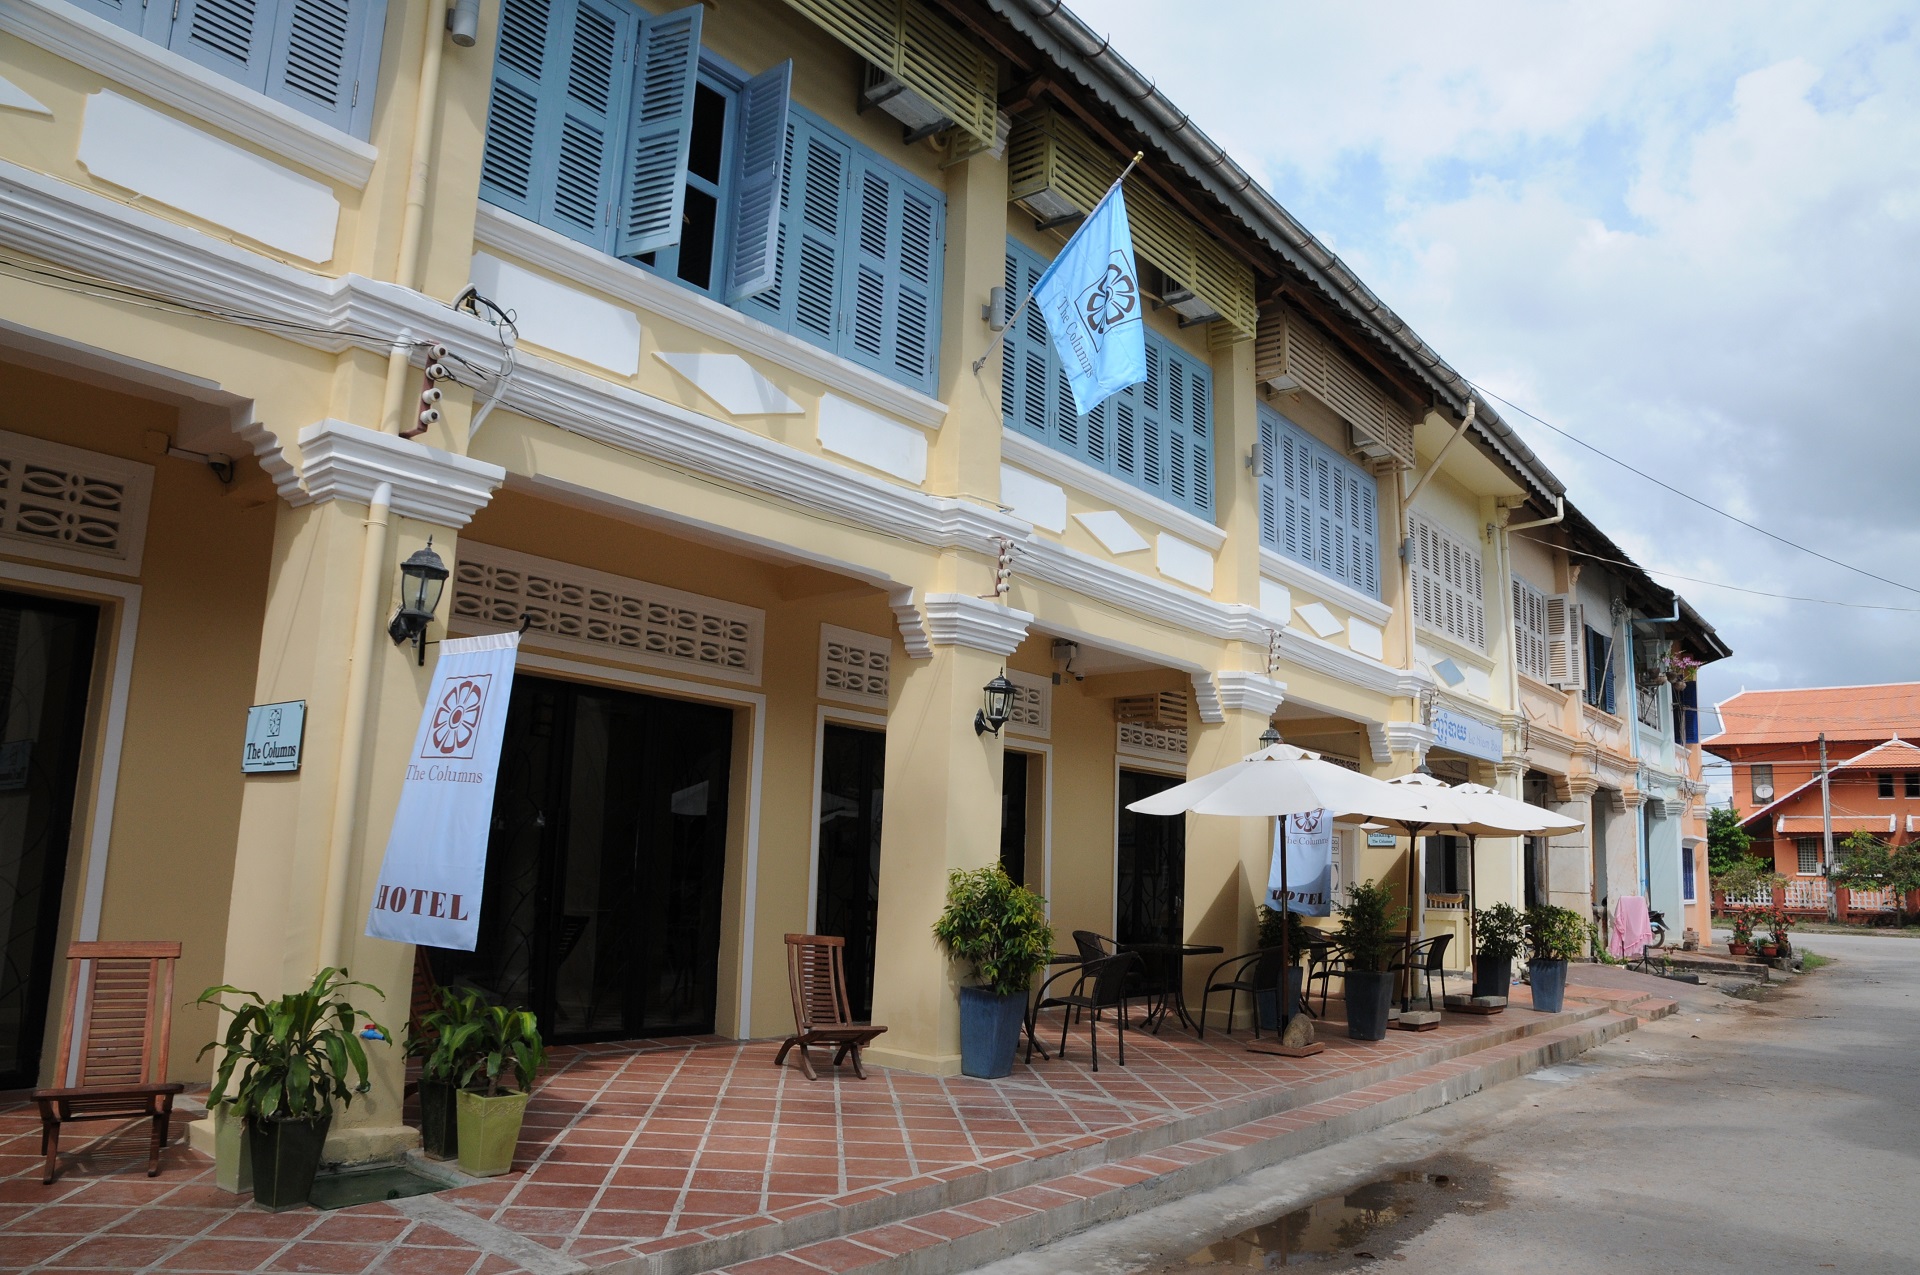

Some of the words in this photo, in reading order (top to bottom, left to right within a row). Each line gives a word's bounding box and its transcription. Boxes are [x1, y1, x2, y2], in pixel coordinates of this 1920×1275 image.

[1057, 296, 1070, 324] The
[1065, 322, 1093, 379] Columns
[247, 742, 261, 760] The
[262, 741, 297, 759] Columns
[405, 764, 425, 783] The
[428, 765, 483, 784] Columns
[1287, 836, 1297, 845] he
[375, 884, 469, 921] HOTEL
